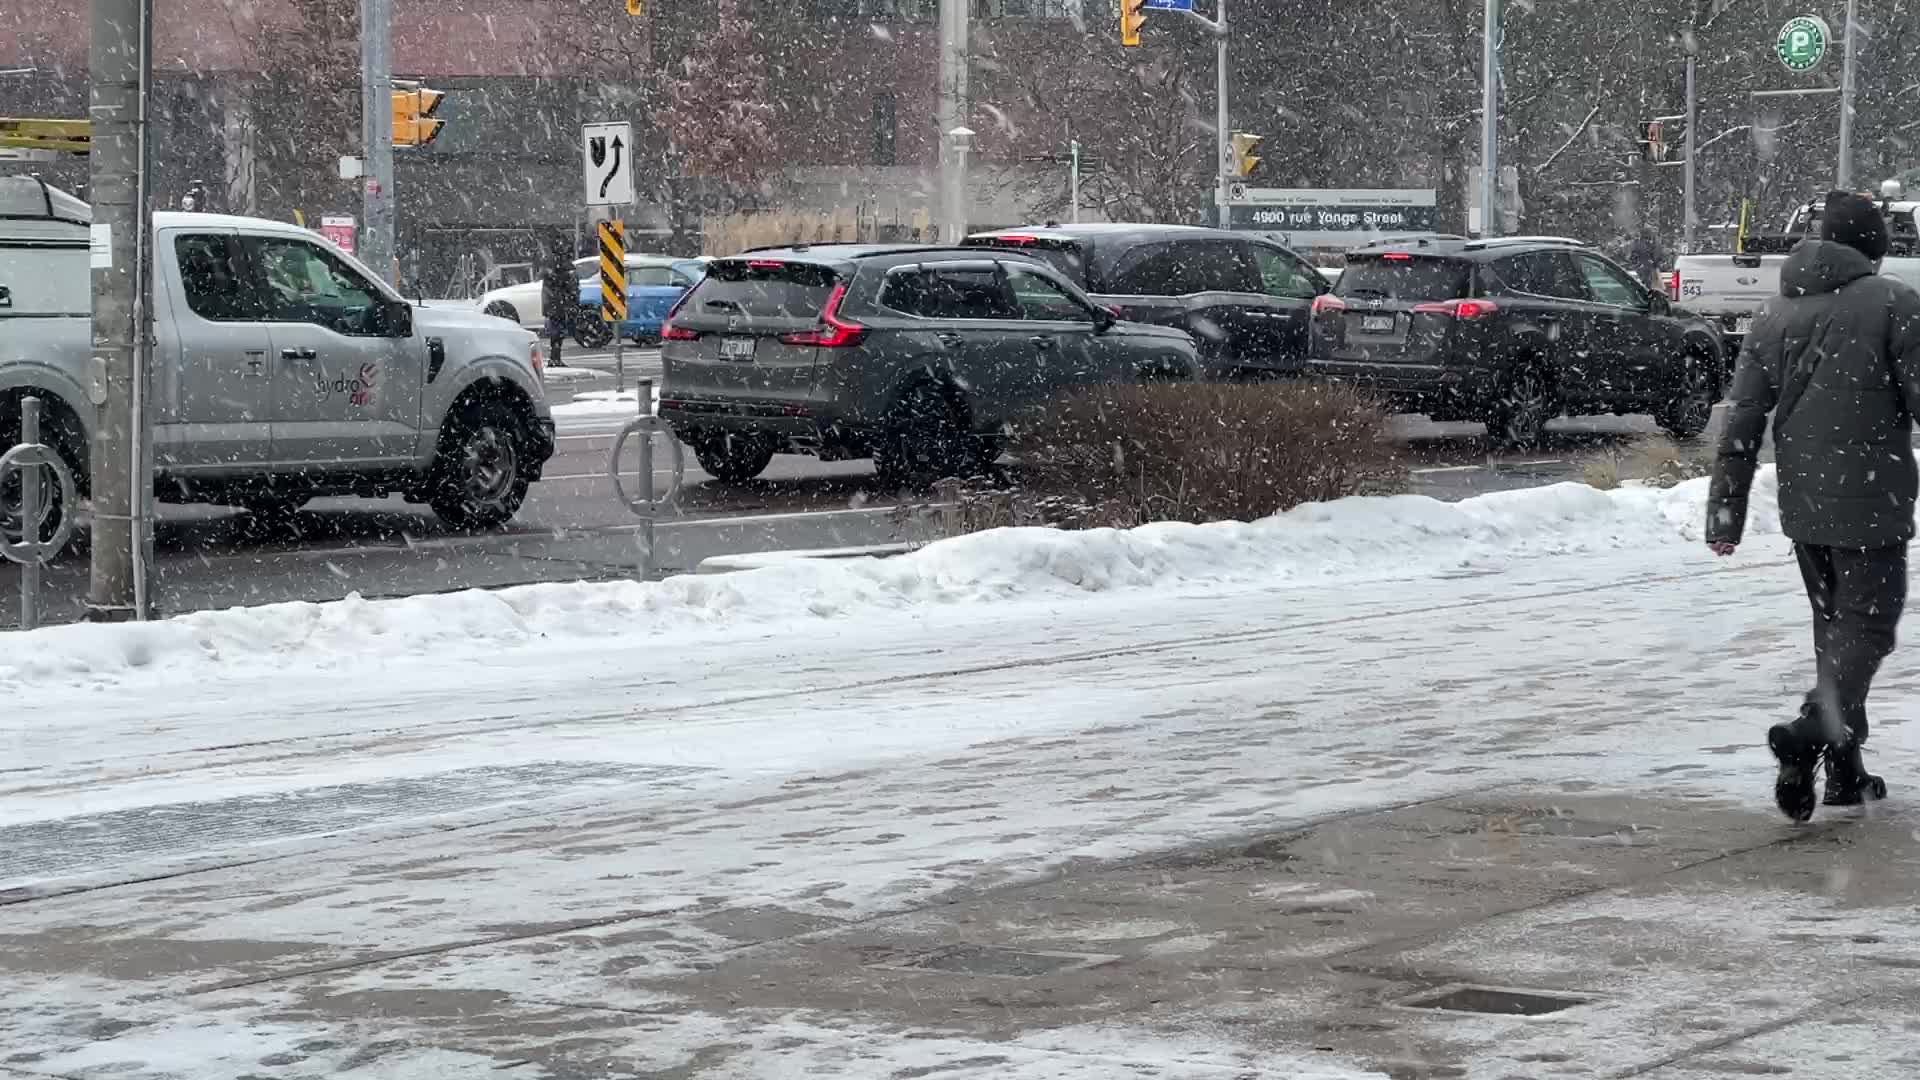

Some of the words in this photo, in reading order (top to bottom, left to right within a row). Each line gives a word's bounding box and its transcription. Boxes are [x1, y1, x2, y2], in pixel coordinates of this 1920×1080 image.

[1252, 211, 1285, 223] 4900
[1288, 211, 1312, 225] rue
[1317, 211, 1357, 226] Yonge
[1363, 211, 1403, 224] Street
[1682, 285, 1702, 296] 943
[317, 372, 360, 400] hydro
